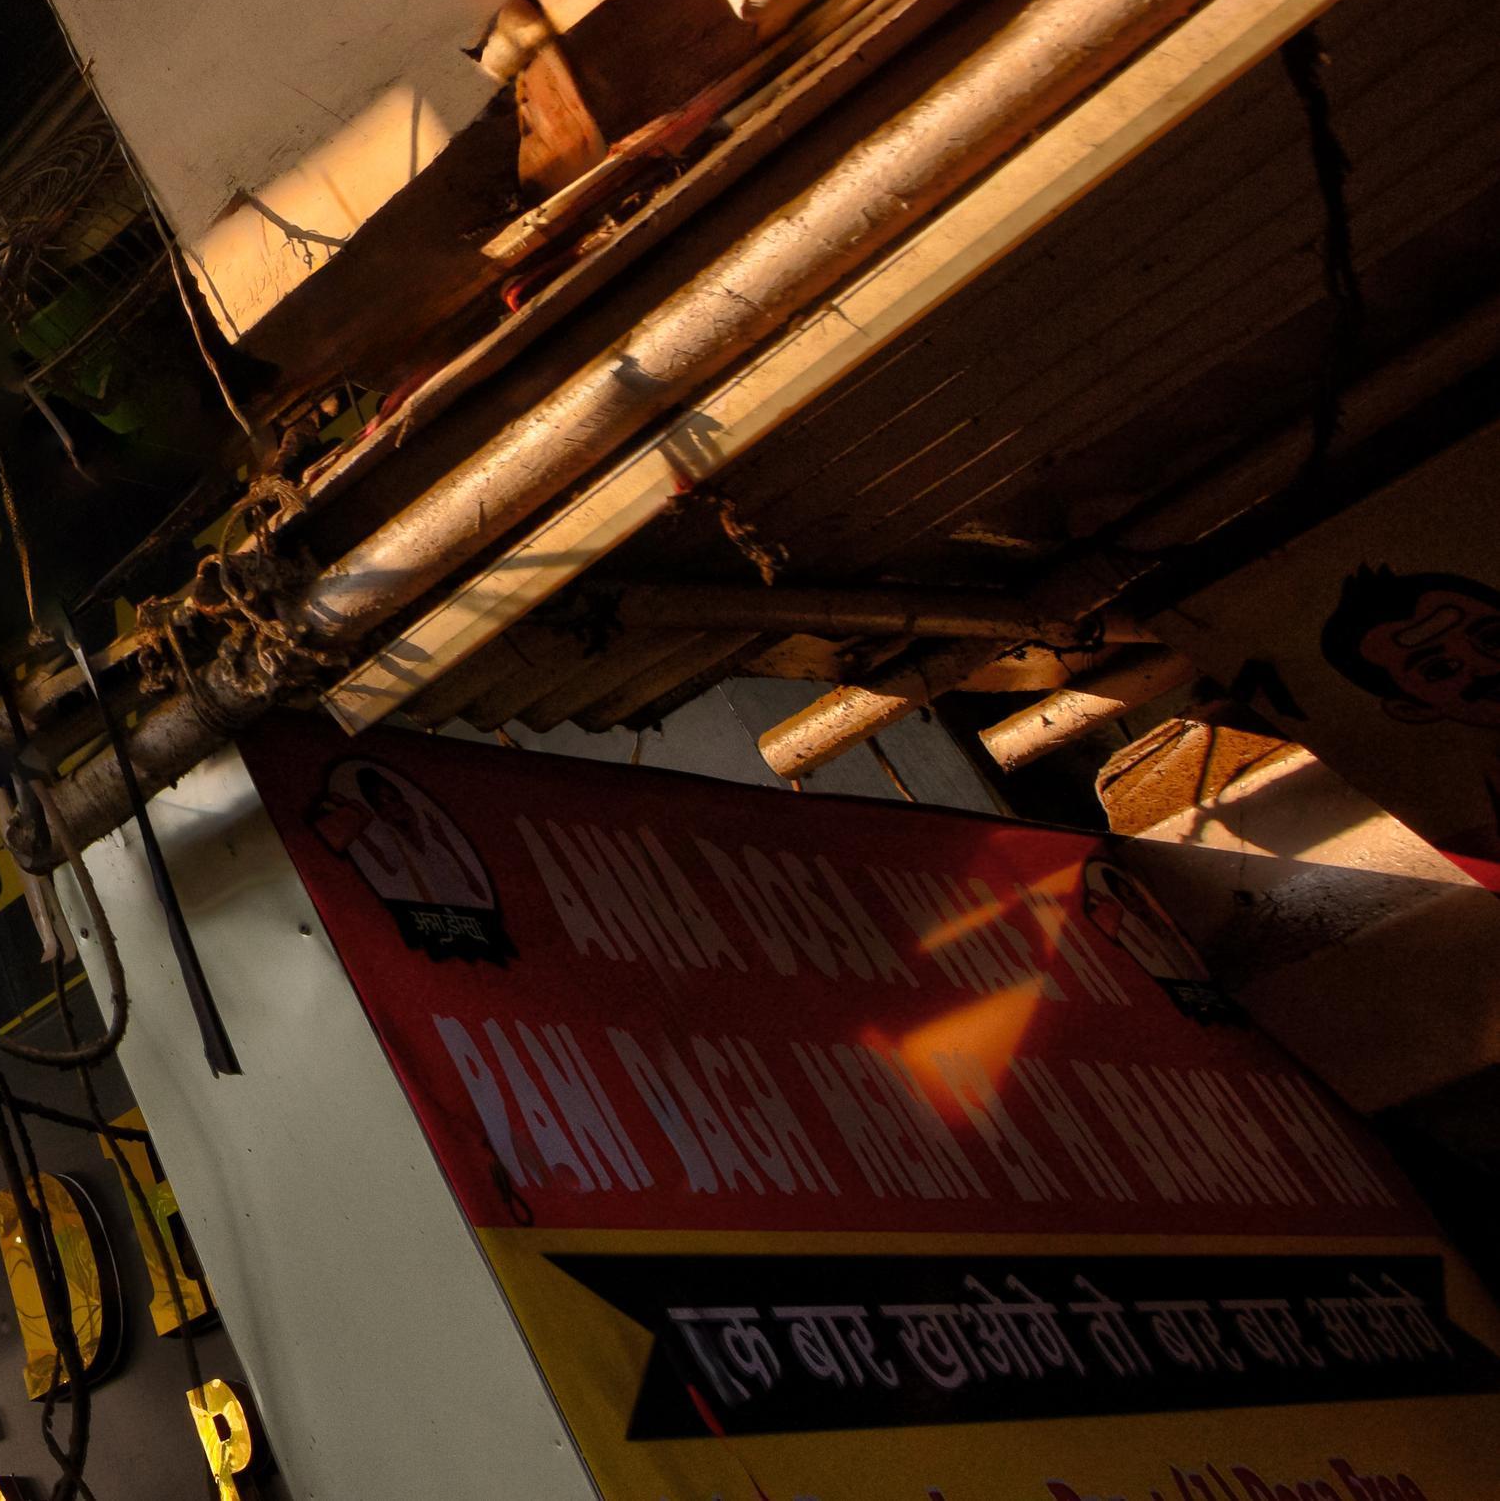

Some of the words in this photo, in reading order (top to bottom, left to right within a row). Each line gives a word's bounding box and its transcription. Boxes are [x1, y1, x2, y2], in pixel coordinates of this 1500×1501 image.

[513, 813, 748, 973] ANNA
[695, 835, 919, 989] DOSA
[1070, 1059, 1317, 1206] BRANCH
[771, 1304, 899, 1389] बार
[879, 1273, 1087, 1390] खाओगे
[1067, 1273, 1157, 1379] तो
[1133, 1300, 1246, 1373] बार
[1219, 1298, 1327, 1370] बार
